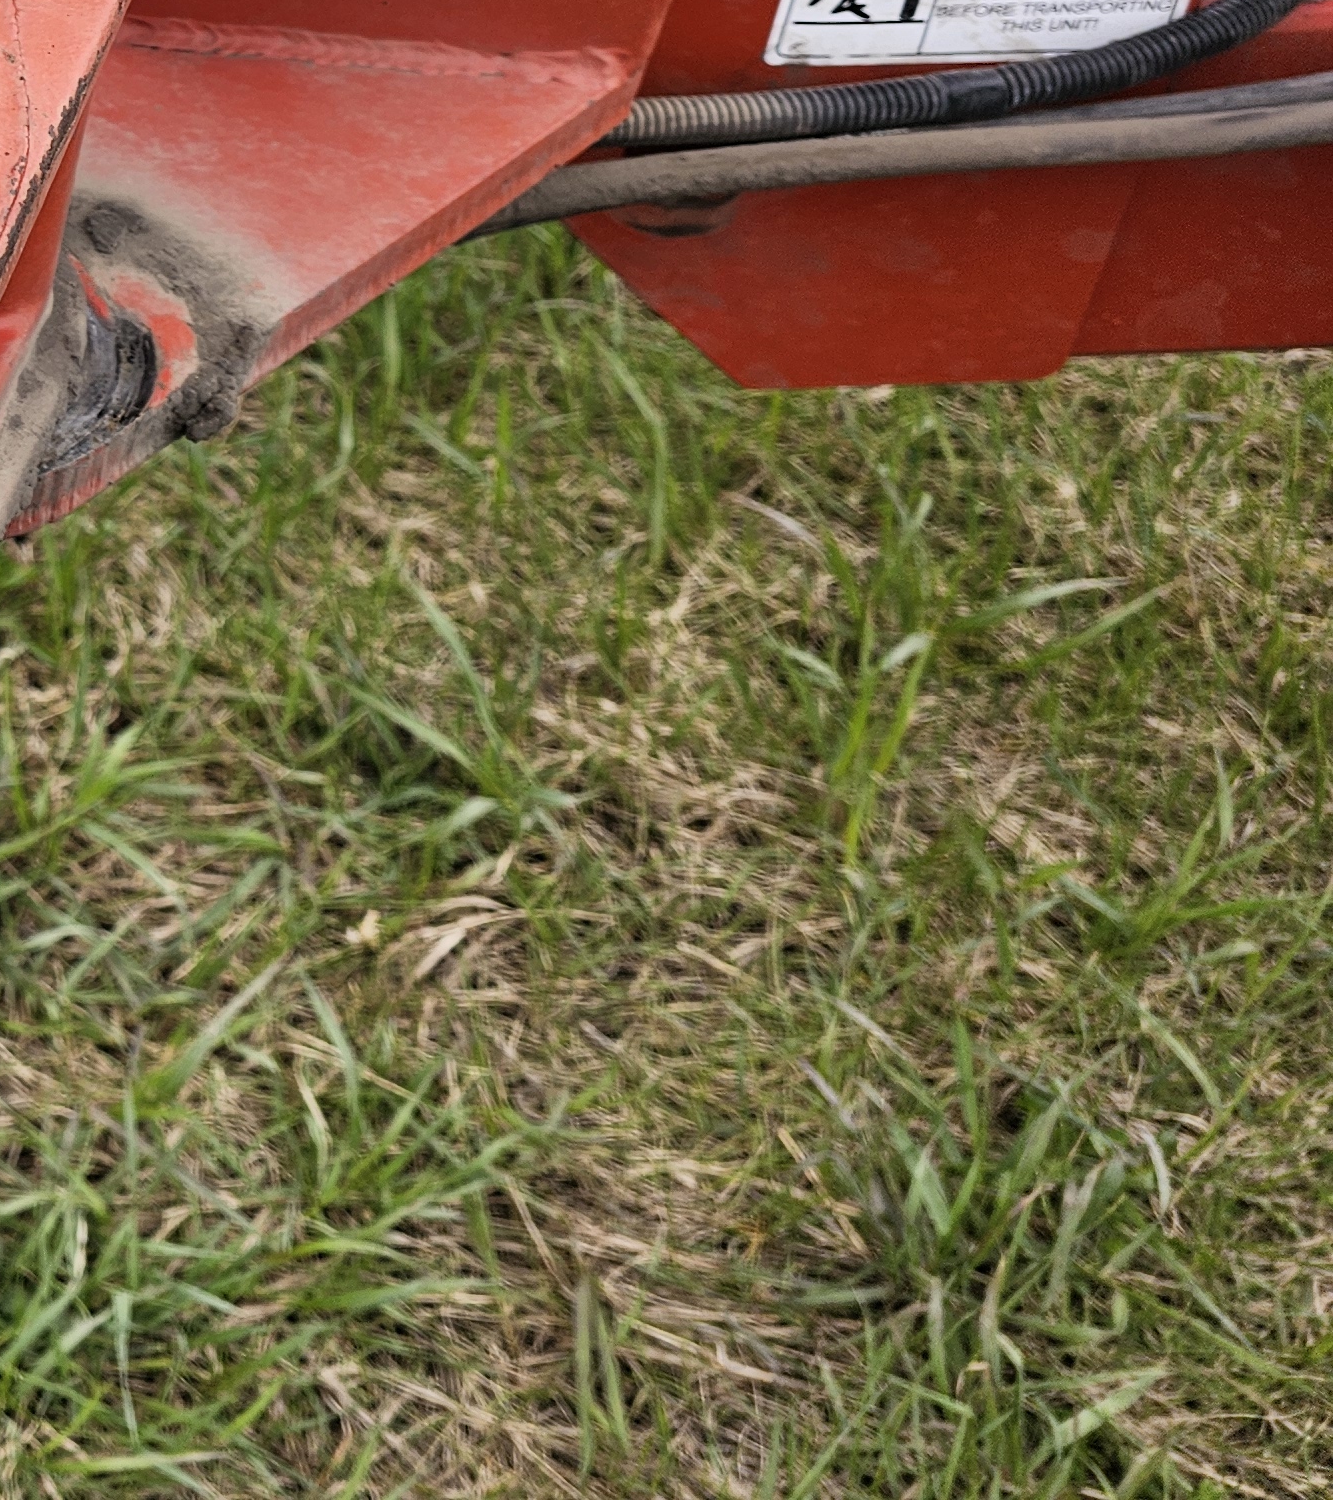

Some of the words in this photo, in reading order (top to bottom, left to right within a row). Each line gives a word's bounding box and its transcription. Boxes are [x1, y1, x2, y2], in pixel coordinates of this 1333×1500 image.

[936, 3, 1018, 16] BEFORE
[1023, 0, 1172, 14] TRANSPORTING
[1001, 19, 1044, 32] THIS
[1049, 18, 1099, 31] UNIT!
